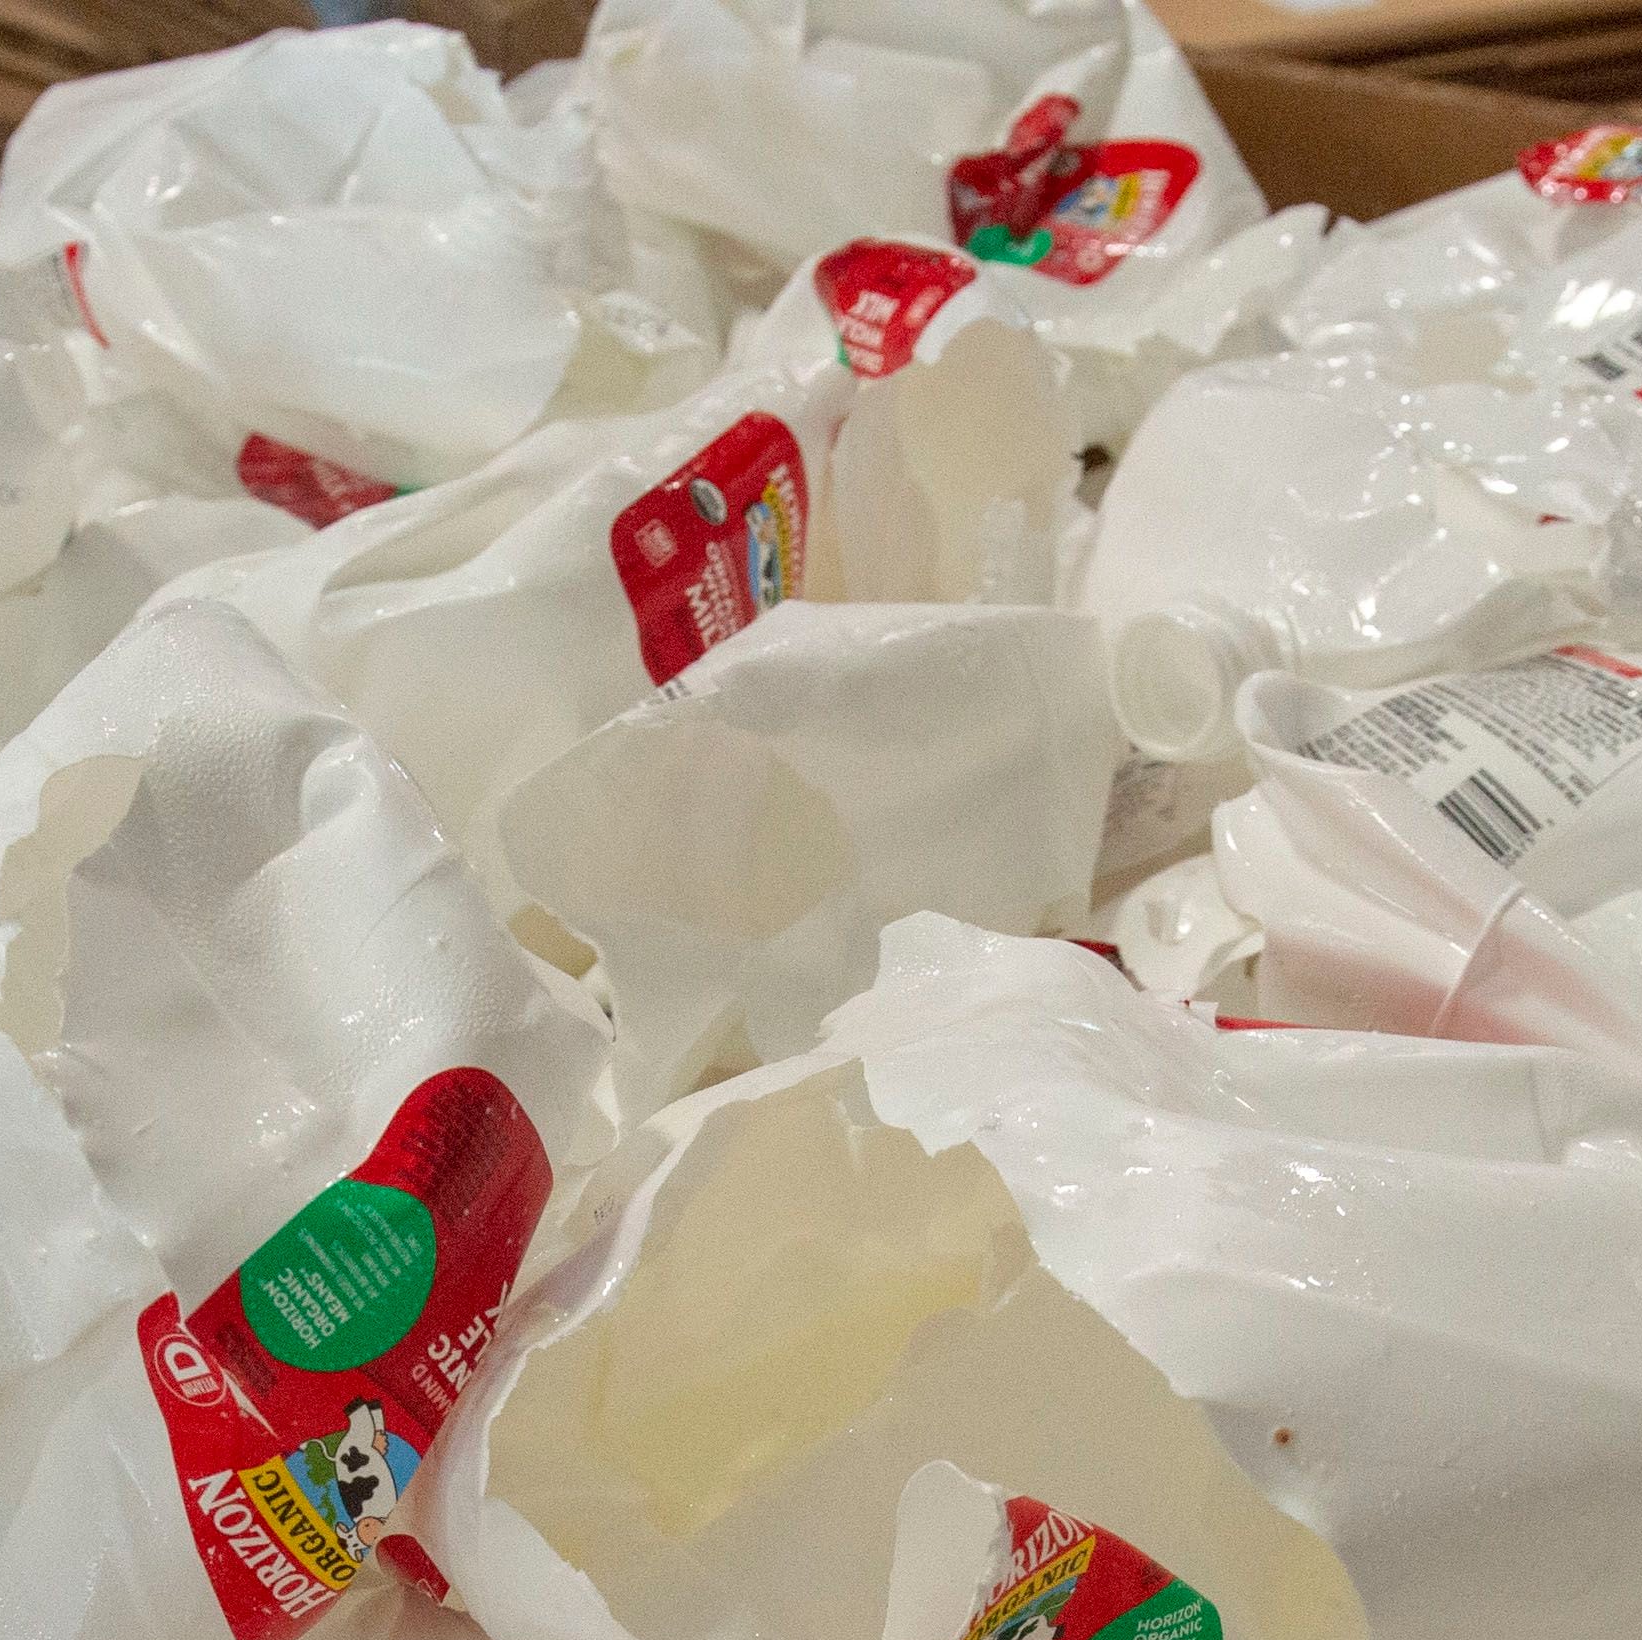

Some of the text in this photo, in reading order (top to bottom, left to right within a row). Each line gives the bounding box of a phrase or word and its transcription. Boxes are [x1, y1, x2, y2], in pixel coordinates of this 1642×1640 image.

[279, 1267, 335, 1336] ORGANIC
[188, 1469, 337, 1619] HORIZON
[253, 1470, 356, 1582] ORGANIC
